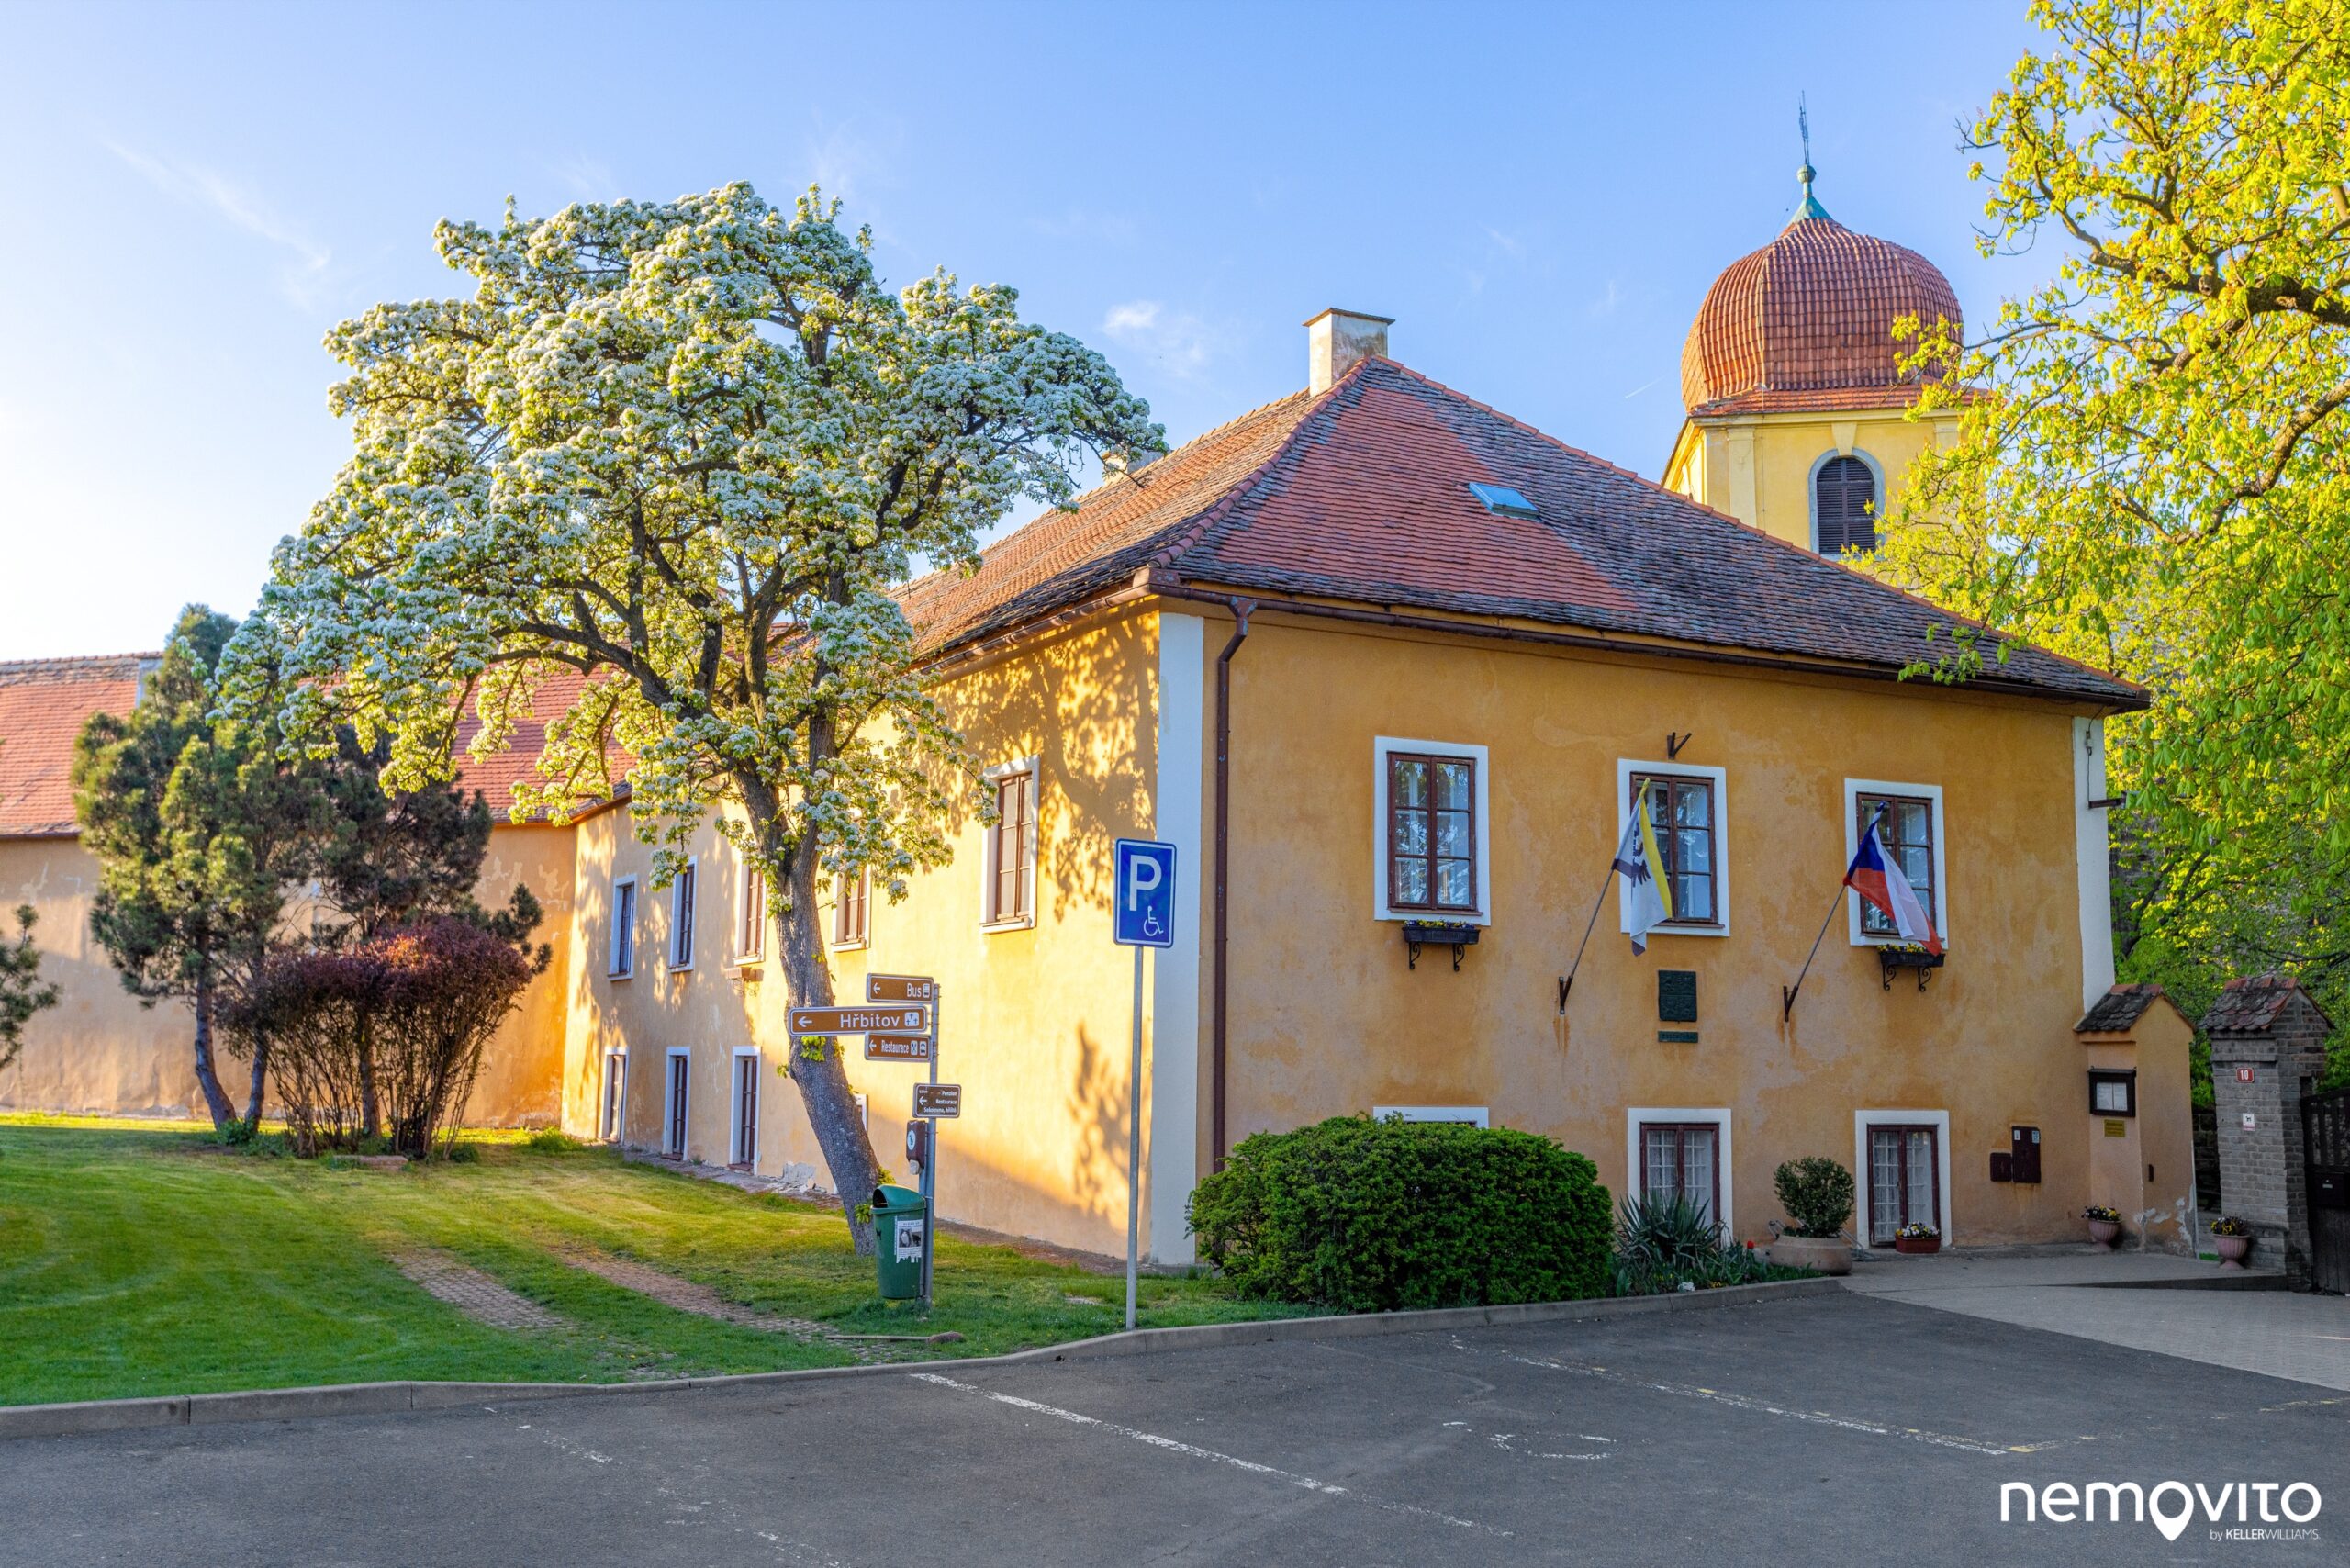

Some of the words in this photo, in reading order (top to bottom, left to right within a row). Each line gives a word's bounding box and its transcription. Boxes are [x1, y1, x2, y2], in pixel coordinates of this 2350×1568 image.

[1129, 855, 1162, 912] P
[906, 983, 922, 998] Bus
[839, 1014, 900, 1028] Hřbitov
[881, 1039, 910, 1054] Restaurace
[2240, 1070, 2249, 1081] 10
